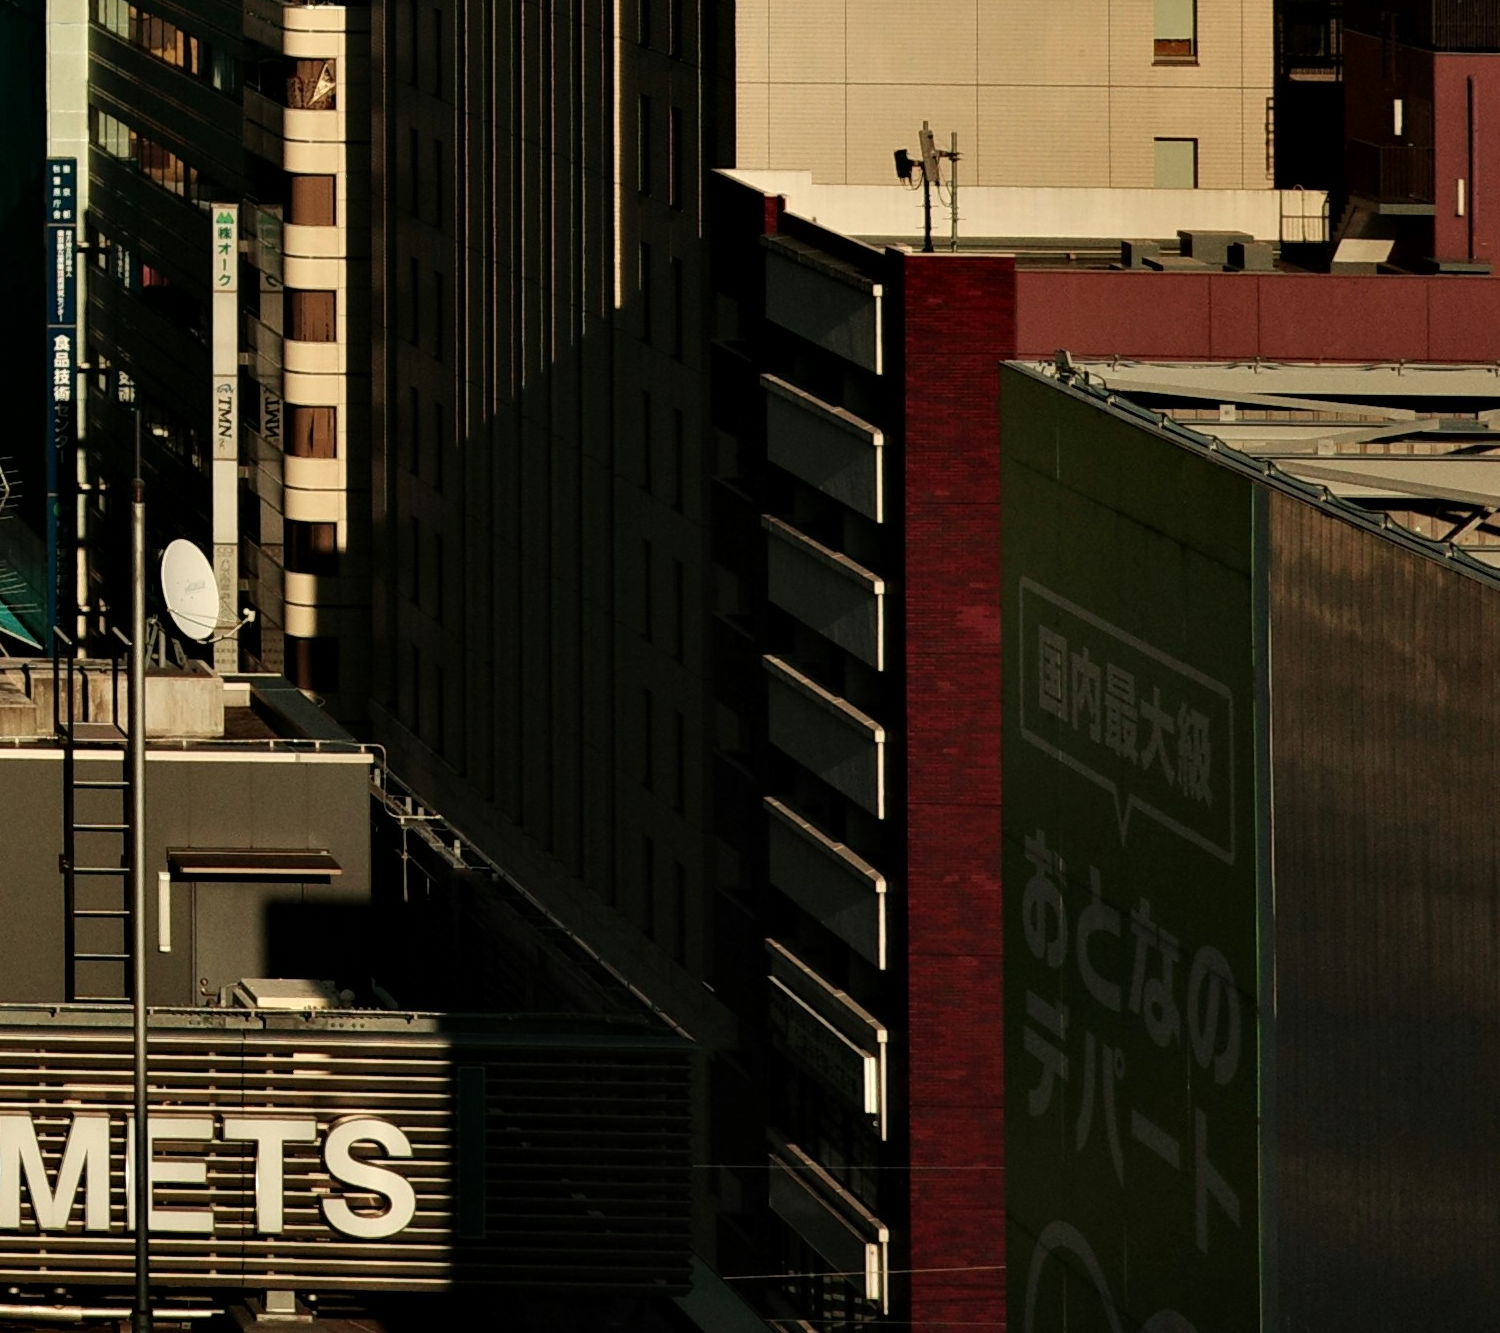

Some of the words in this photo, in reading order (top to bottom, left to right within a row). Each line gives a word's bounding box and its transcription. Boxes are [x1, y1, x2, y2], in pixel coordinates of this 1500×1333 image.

[1037, 622, 1215, 810] 国内最大級
[1021, 827, 1242, 1088] おとなの
[1024, 988, 1241, 1255] デパート
